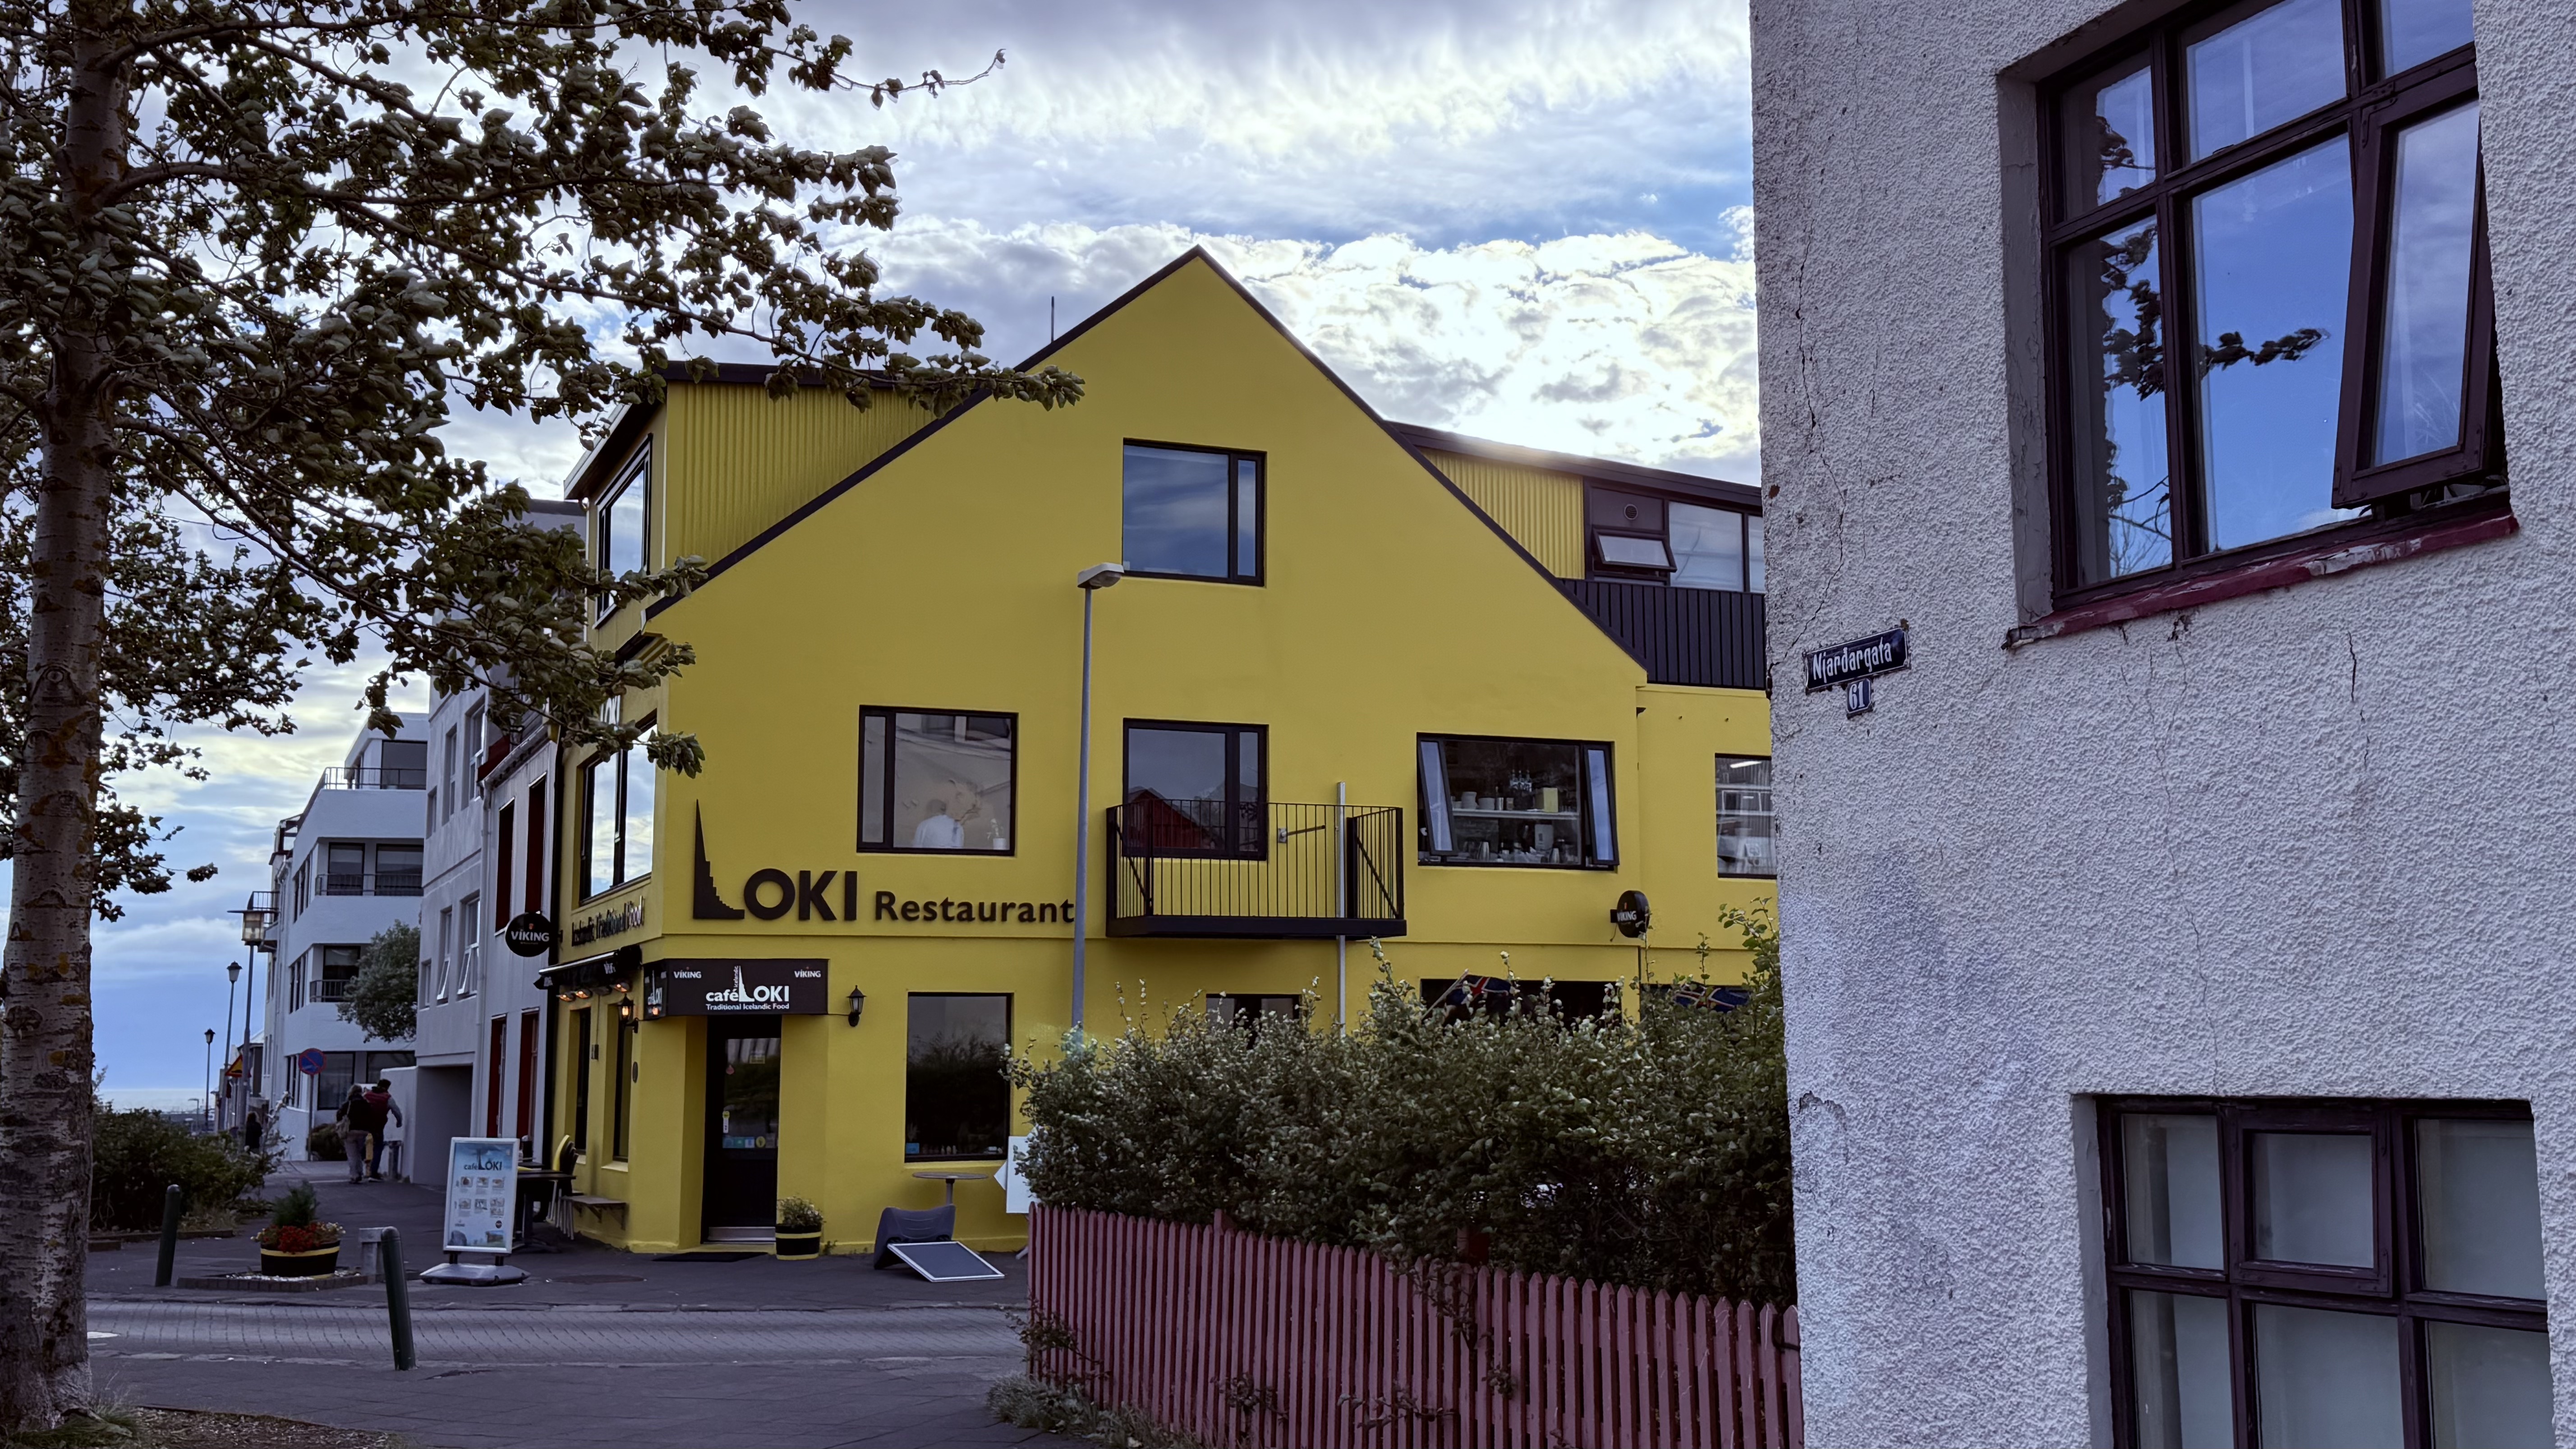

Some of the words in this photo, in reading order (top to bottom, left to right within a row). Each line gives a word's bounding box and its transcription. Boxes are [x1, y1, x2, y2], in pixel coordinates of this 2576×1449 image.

[1849, 681, 1865, 709] 61
[693, 799, 858, 920] LOKI
[875, 890, 1075, 923] Restaurant
[706, 989, 739, 1002] café
[739, 966, 789, 1002] LOKI
[478, 1149, 502, 1171] LOKI
